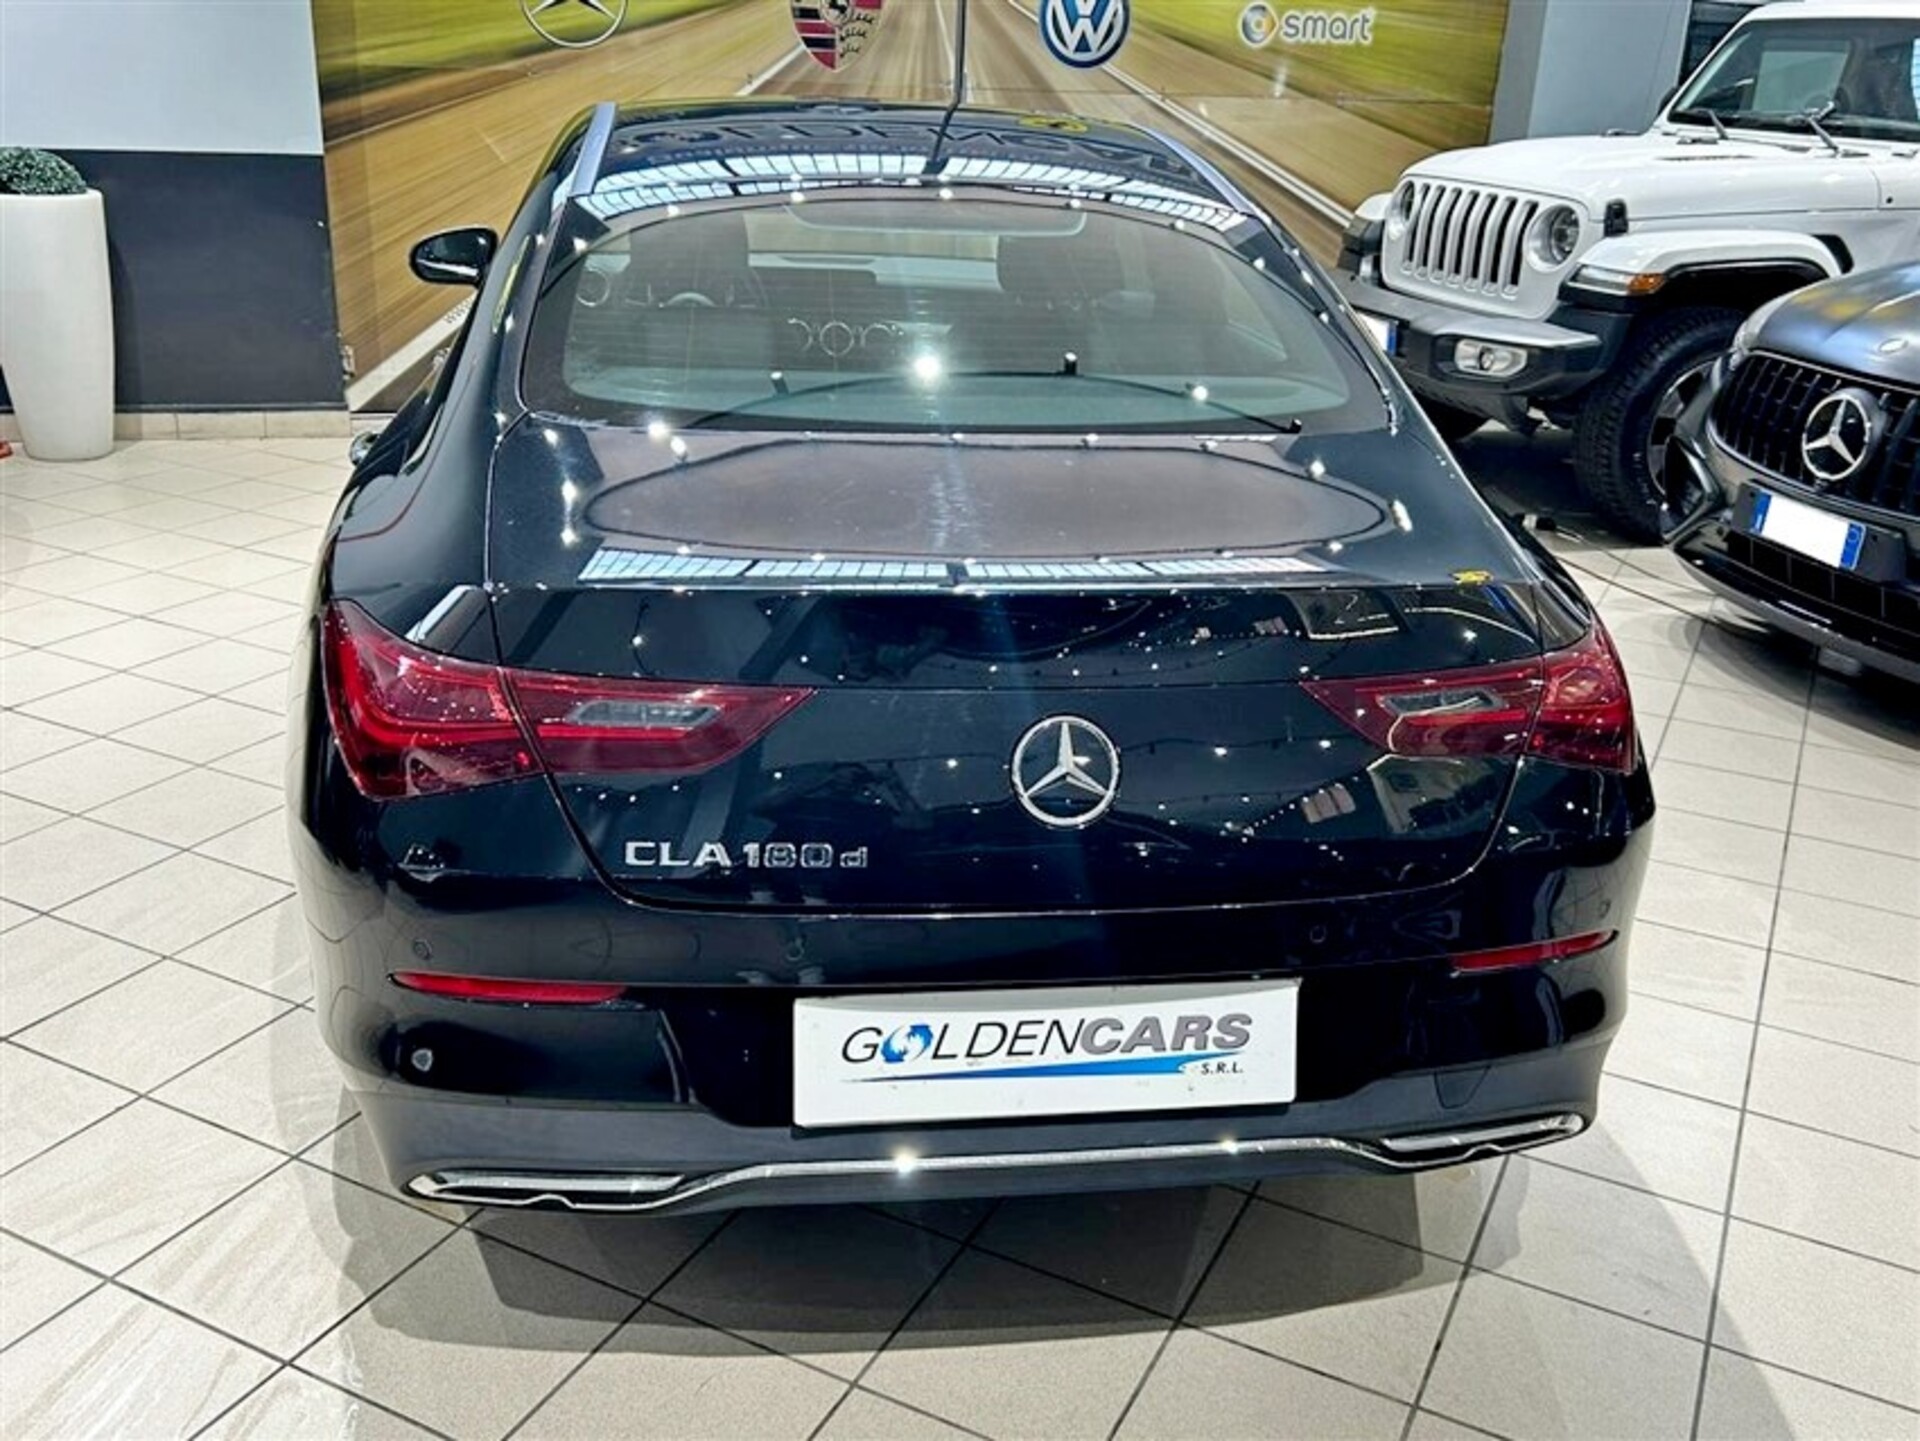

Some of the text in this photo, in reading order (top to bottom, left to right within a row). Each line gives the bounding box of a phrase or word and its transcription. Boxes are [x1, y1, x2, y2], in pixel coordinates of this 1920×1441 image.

[1282, 12, 1373, 41] smart
[625, 842, 868, 868] CLA 180 d
[1201, 1061, 1244, 1075] S.R.L.
